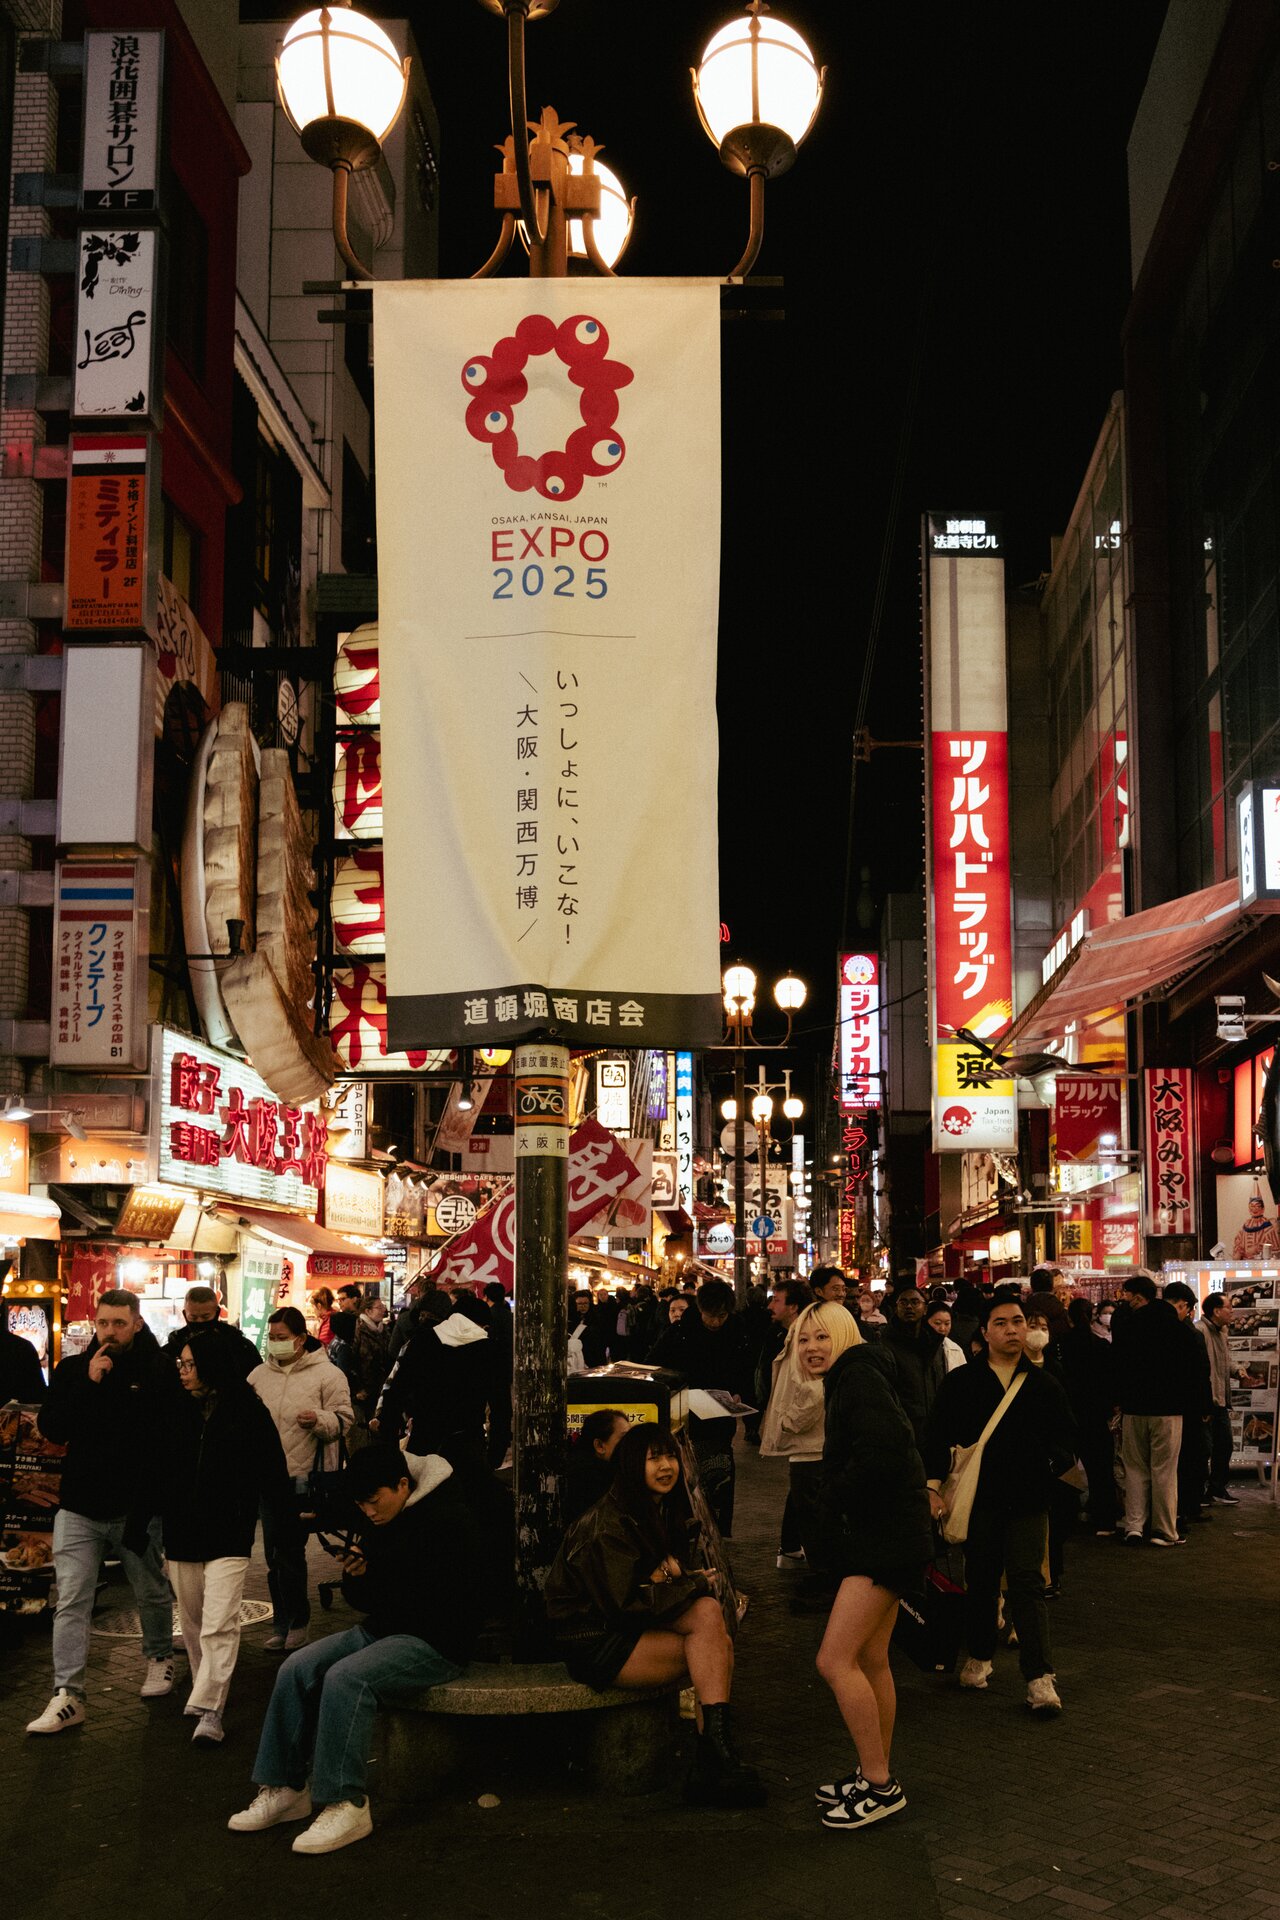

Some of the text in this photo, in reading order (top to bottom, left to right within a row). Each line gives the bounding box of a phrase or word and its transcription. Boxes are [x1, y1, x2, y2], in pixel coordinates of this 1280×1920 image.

[106, 35, 141, 188] 浪花囲碁サロン
[78, 310, 146, 369] Leaf
[125, 479, 140, 570] 本格インド料理店
[491, 513, 608, 525] OSAKA, KANSAI, JAPAN
[95, 479, 121, 599] ミティラー
[491, 526, 609, 562] EXPO
[934, 535, 999, 549] 法善寺ビル
[123, 577, 138, 588] 2F
[492, 564, 608, 600] 2025
[515, 704, 539, 910] 大阪・関西万博
[948, 740, 995, 1000] ツルハドラッグ
[71, 930, 84, 1042] タイカルチャースクール
[86, 923, 107, 1027] クンテープ
[111, 930, 124, 1043] タイ料理とタイスキの店
[59, 1006, 70, 1043] 食材店
[464, 991, 645, 1027] 道頓堀商店会
[111, 1046, 123, 1057] B1
[851, 989, 871, 1099] ジャンカラ
[170, 1052, 222, 1114] 餃子
[957, 1052, 995, 1089] 薬
[1058, 1082, 1119, 1101] ツルハ
[354, 1104, 363, 1136] CAFE
[992, 1125, 1012, 1133] Shop
[1059, 1105, 1108, 1119] ドラッグ
[219, 1086, 330, 1190] 大阪王将
[519, 1137, 566, 1150] 大阪市
[1153, 1078, 1190, 1224] 大阪みやげ
[1062, 1223, 1082, 1250] 薬
[14, 1463, 42, 1471] SUKIYAKI
